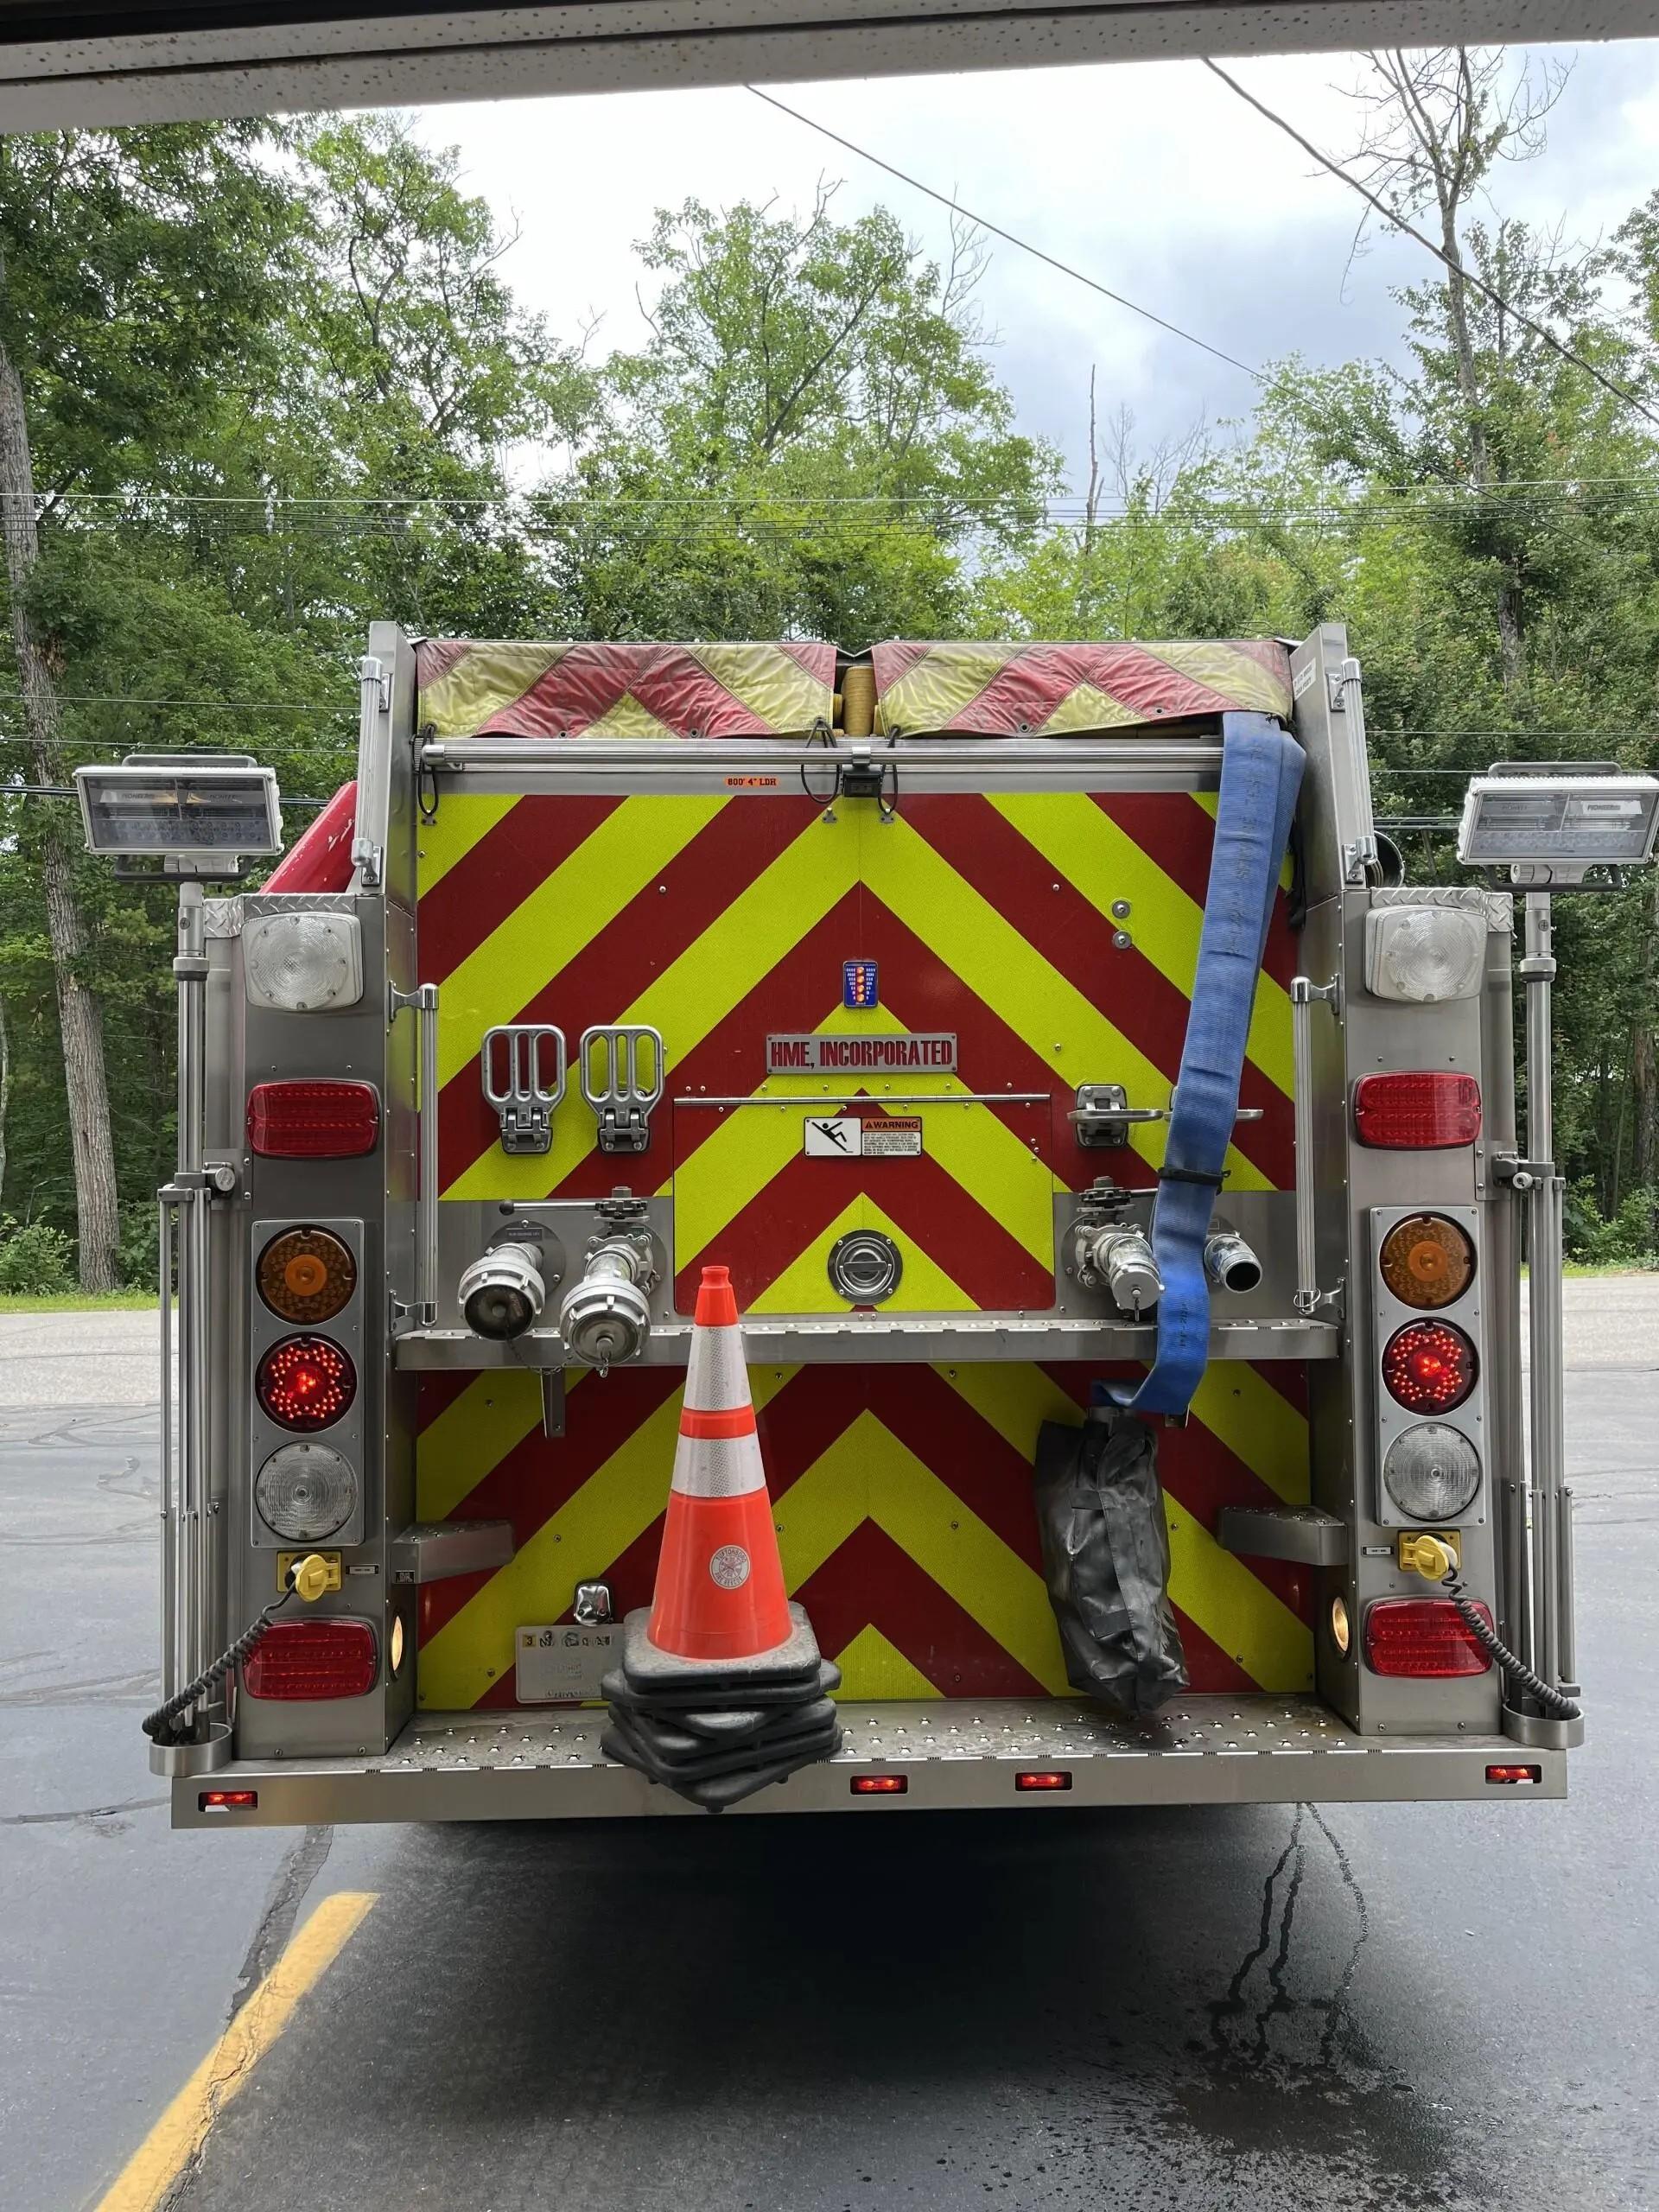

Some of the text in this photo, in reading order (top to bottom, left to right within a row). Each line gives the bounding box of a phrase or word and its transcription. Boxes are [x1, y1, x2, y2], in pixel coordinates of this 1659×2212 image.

[771, 1040, 953, 1069] HME, INCORPORATED
[526, 1637, 533, 1646] 3
